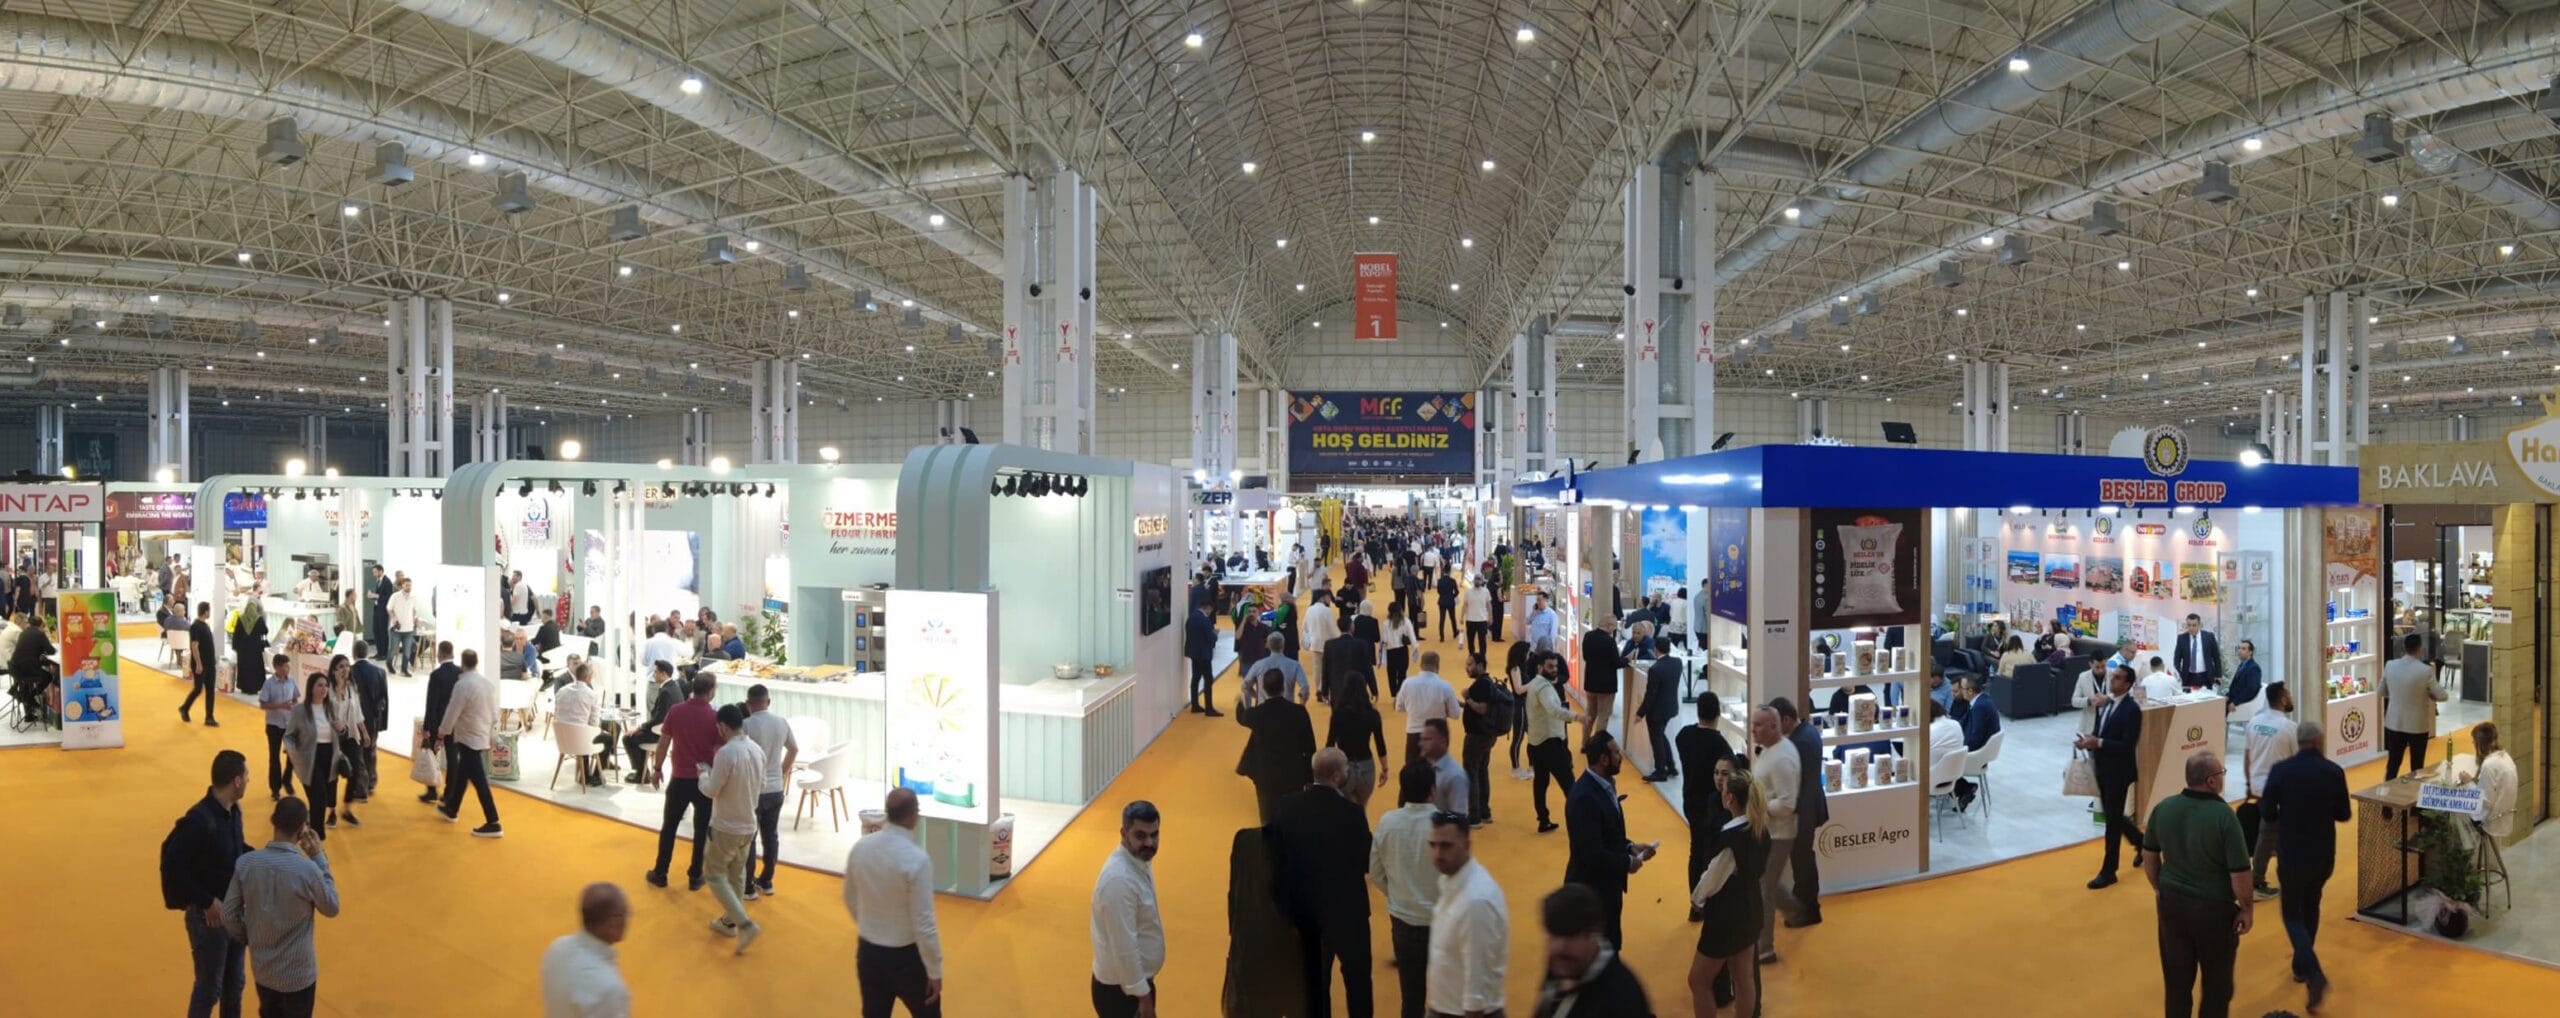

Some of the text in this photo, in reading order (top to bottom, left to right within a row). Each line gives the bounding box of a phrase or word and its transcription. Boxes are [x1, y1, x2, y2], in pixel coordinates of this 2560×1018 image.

[1360, 263, 1392, 272] NOBEL
[1371, 320, 1380, 337] 1
[1312, 432, 1354, 452] HOŞ
[2378, 460, 2499, 489] BAKLAVA
[2101, 480, 2226, 506] BEŞLER GROUP
[1834, 829, 1910, 848] BESLER Agro
